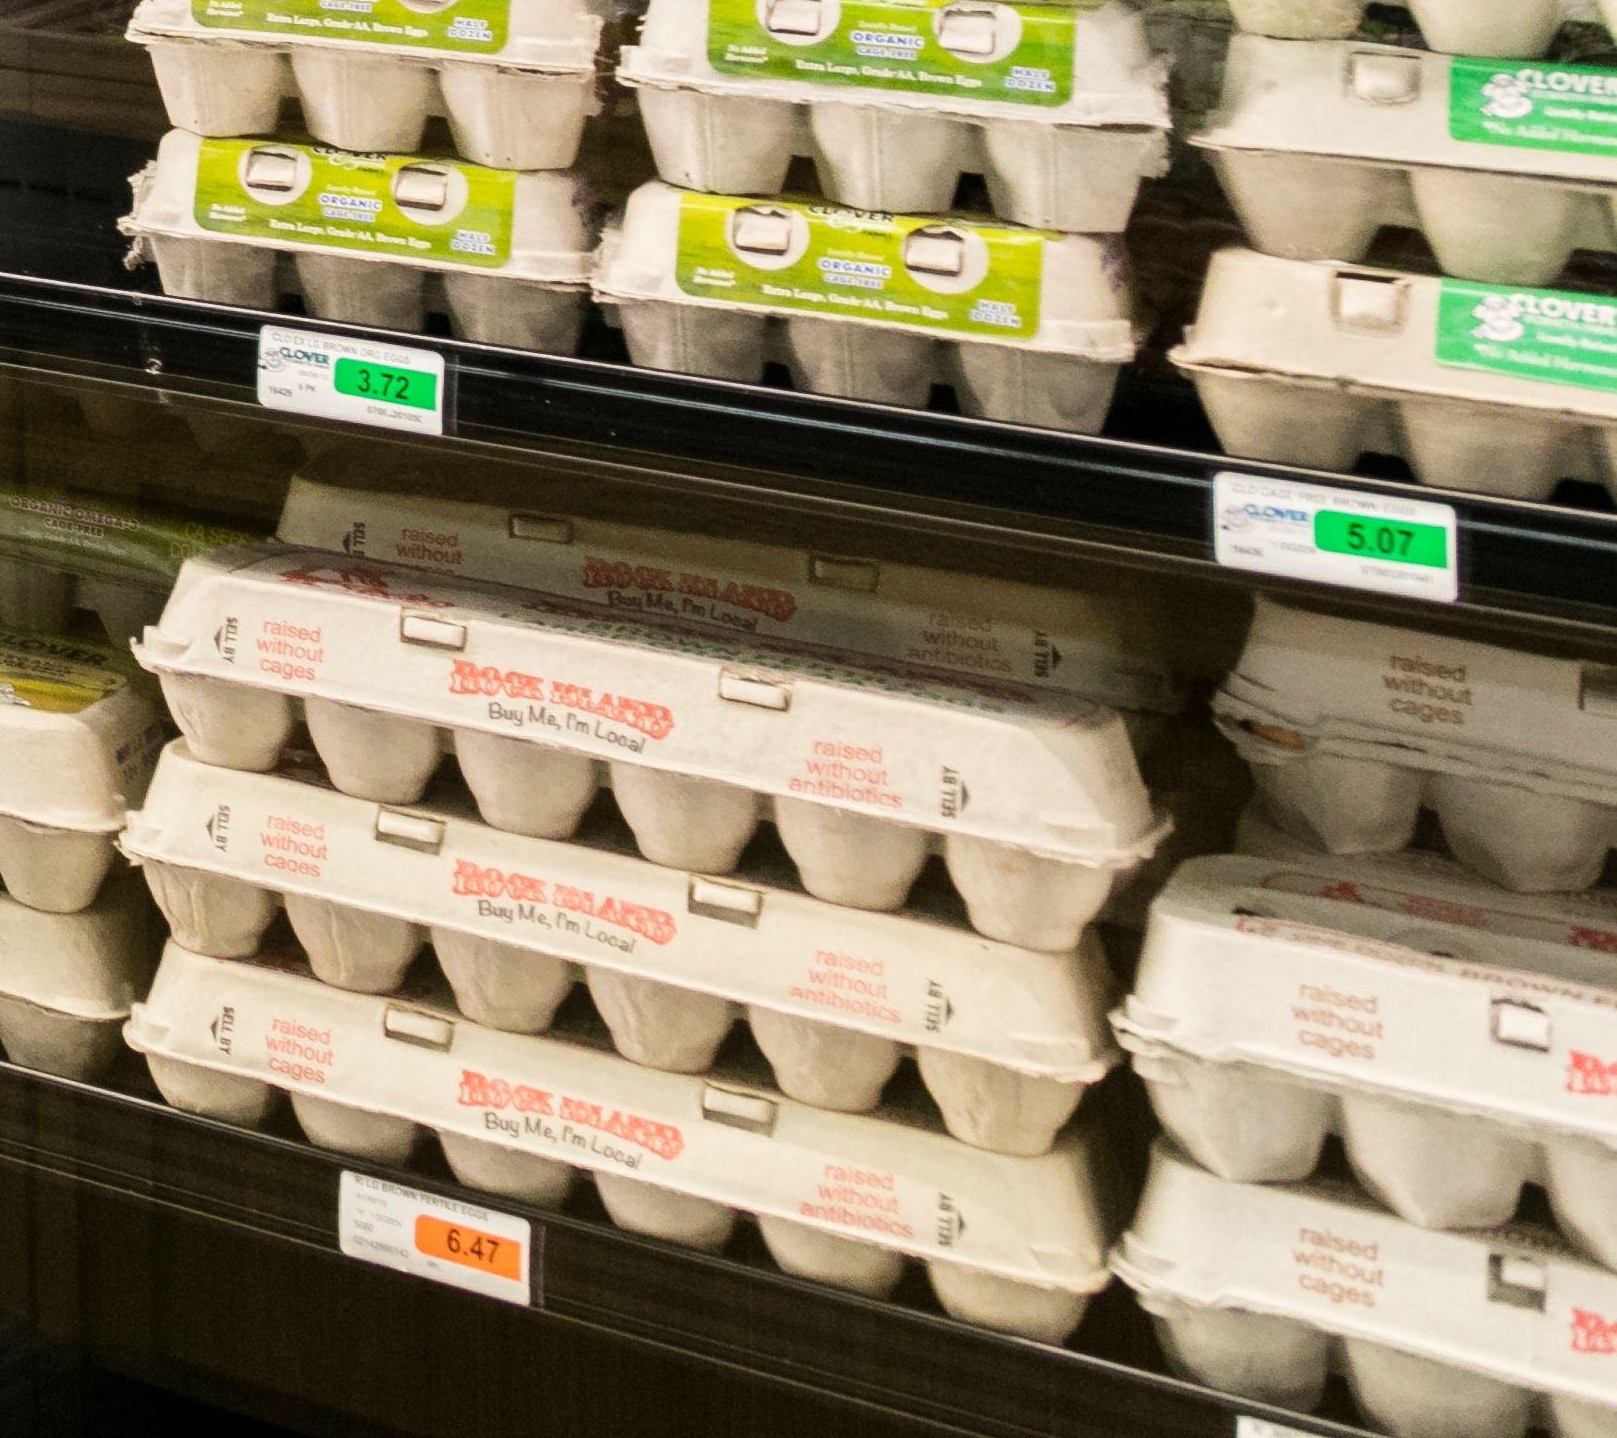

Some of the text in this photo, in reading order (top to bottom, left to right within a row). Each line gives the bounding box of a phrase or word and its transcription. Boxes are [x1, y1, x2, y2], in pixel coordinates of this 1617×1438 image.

[450, 29, 491, 41] DOZEN
[454, 19, 487, 30] HALF
[356, 369, 411, 401] 3.72
[1347, 523, 1415, 556] 5.07
[262, 620, 321, 643] raised
[256, 636, 324, 663] without
[259, 657, 316, 681] cages
[450, 659, 674, 741] ROCK ISLAND
[488, 702, 646, 754] Buy Me, I'm Local
[447, 1228, 501, 1265] 6.47
